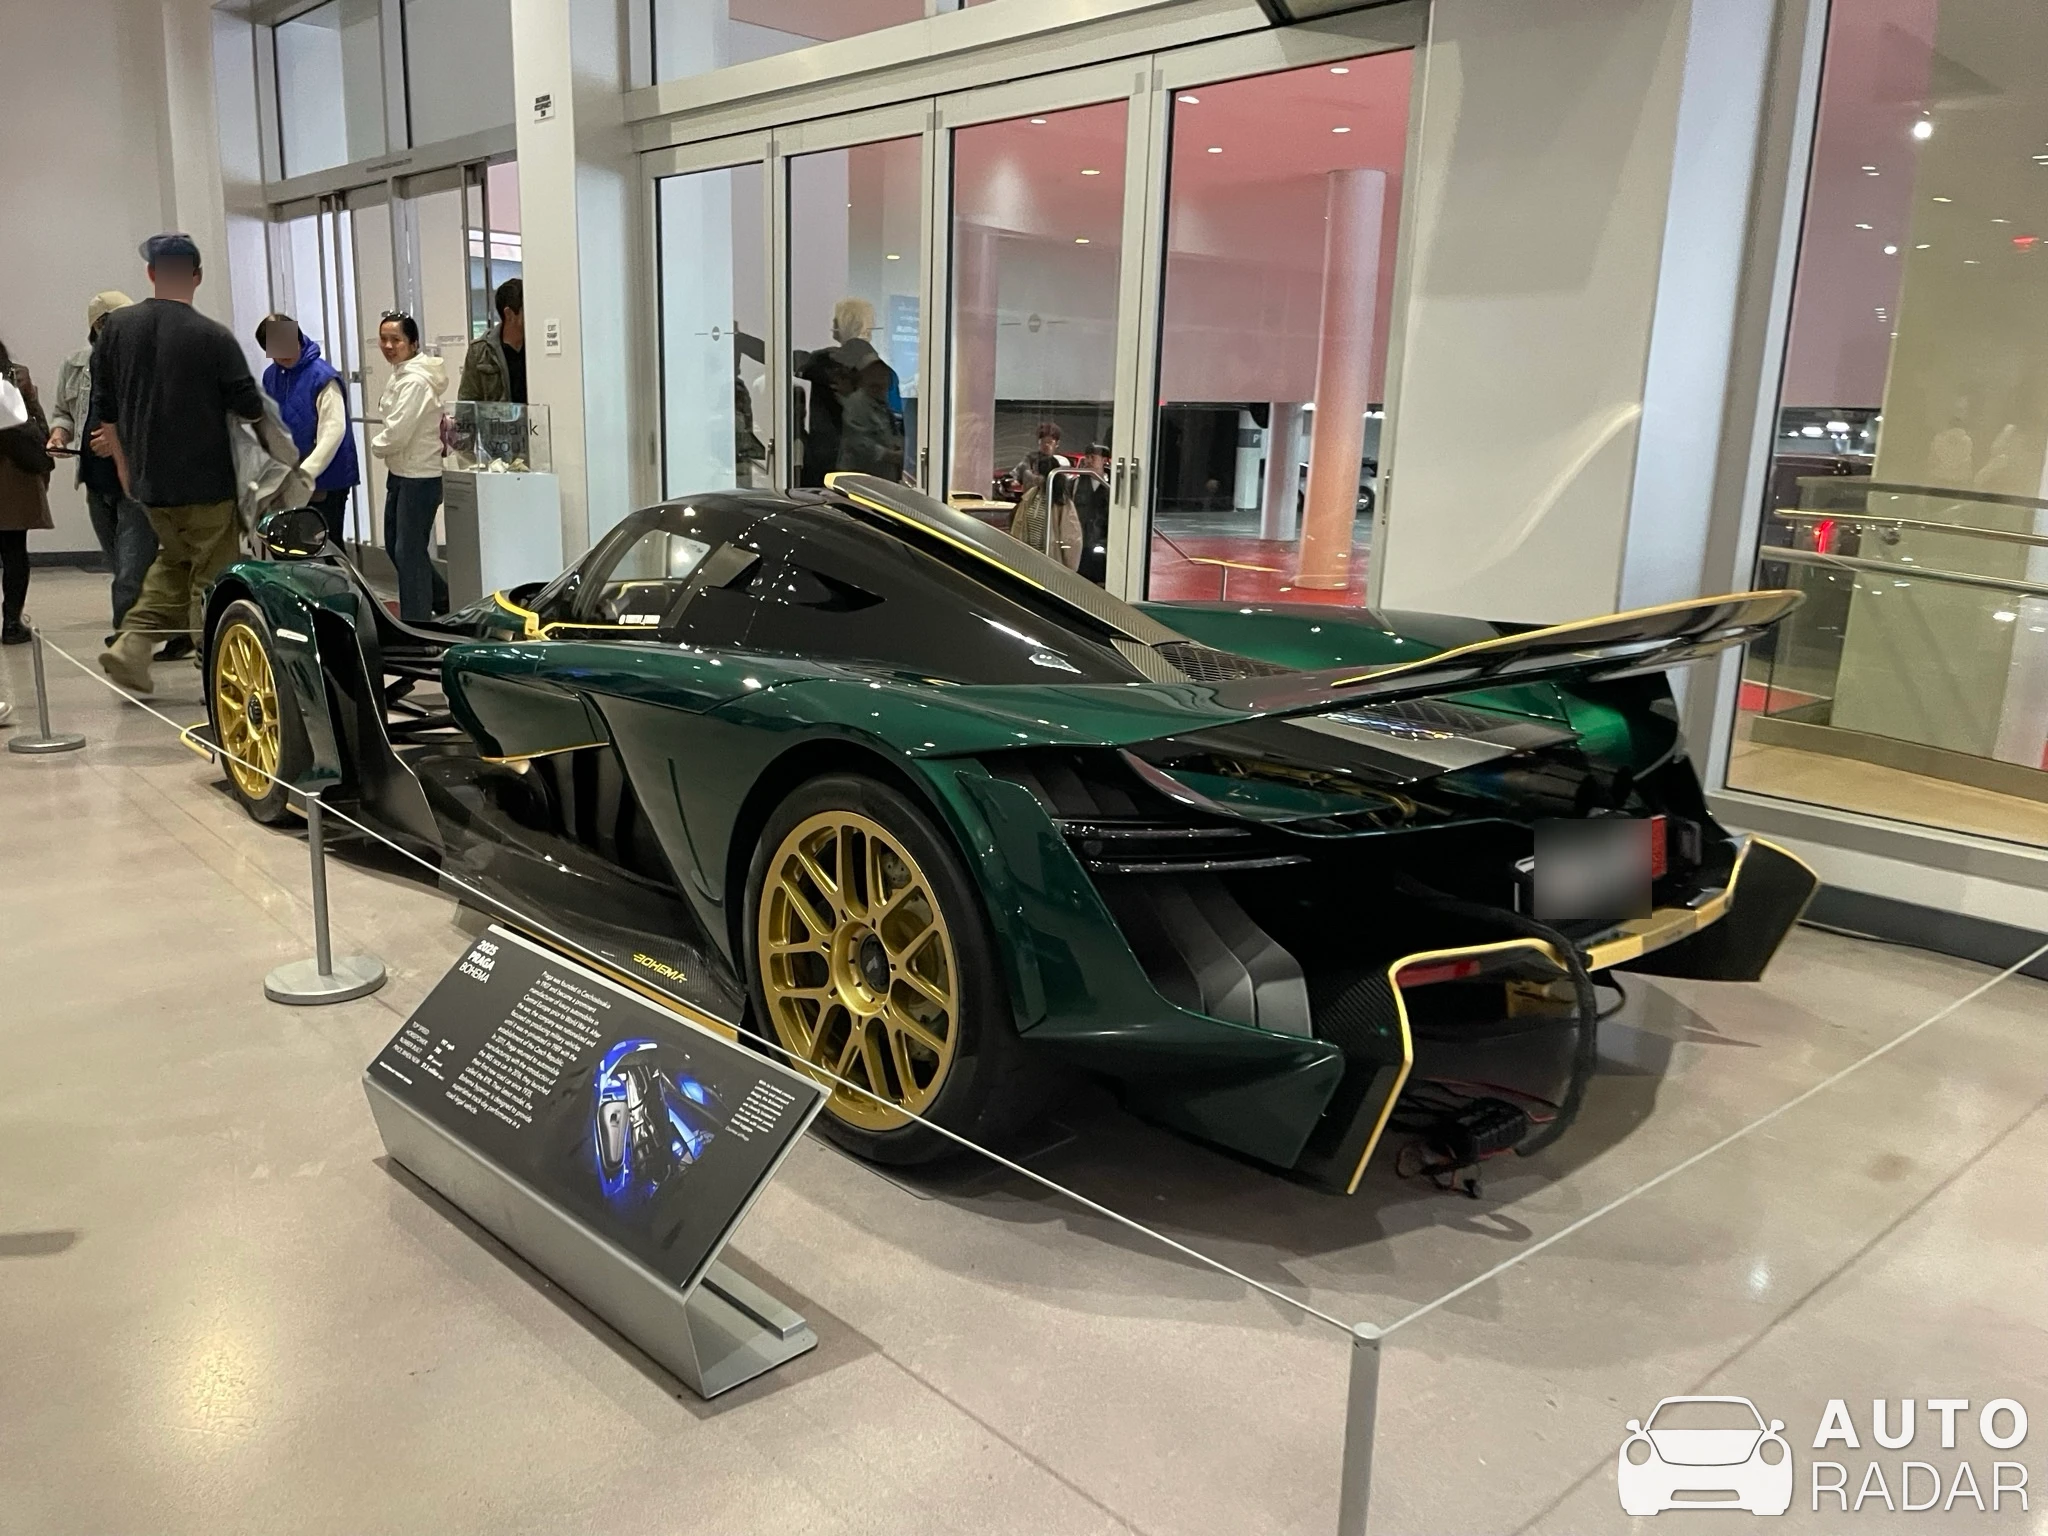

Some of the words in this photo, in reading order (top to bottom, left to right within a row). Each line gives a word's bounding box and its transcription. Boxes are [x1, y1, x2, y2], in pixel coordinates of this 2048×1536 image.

[486, 418, 539, 436] Thank
[476, 939, 499, 956] 2025
[467, 950, 495, 971] PRAGA
[633, 953, 688, 984] BOHEMA
[458, 961, 490, 984] BOHEMA
